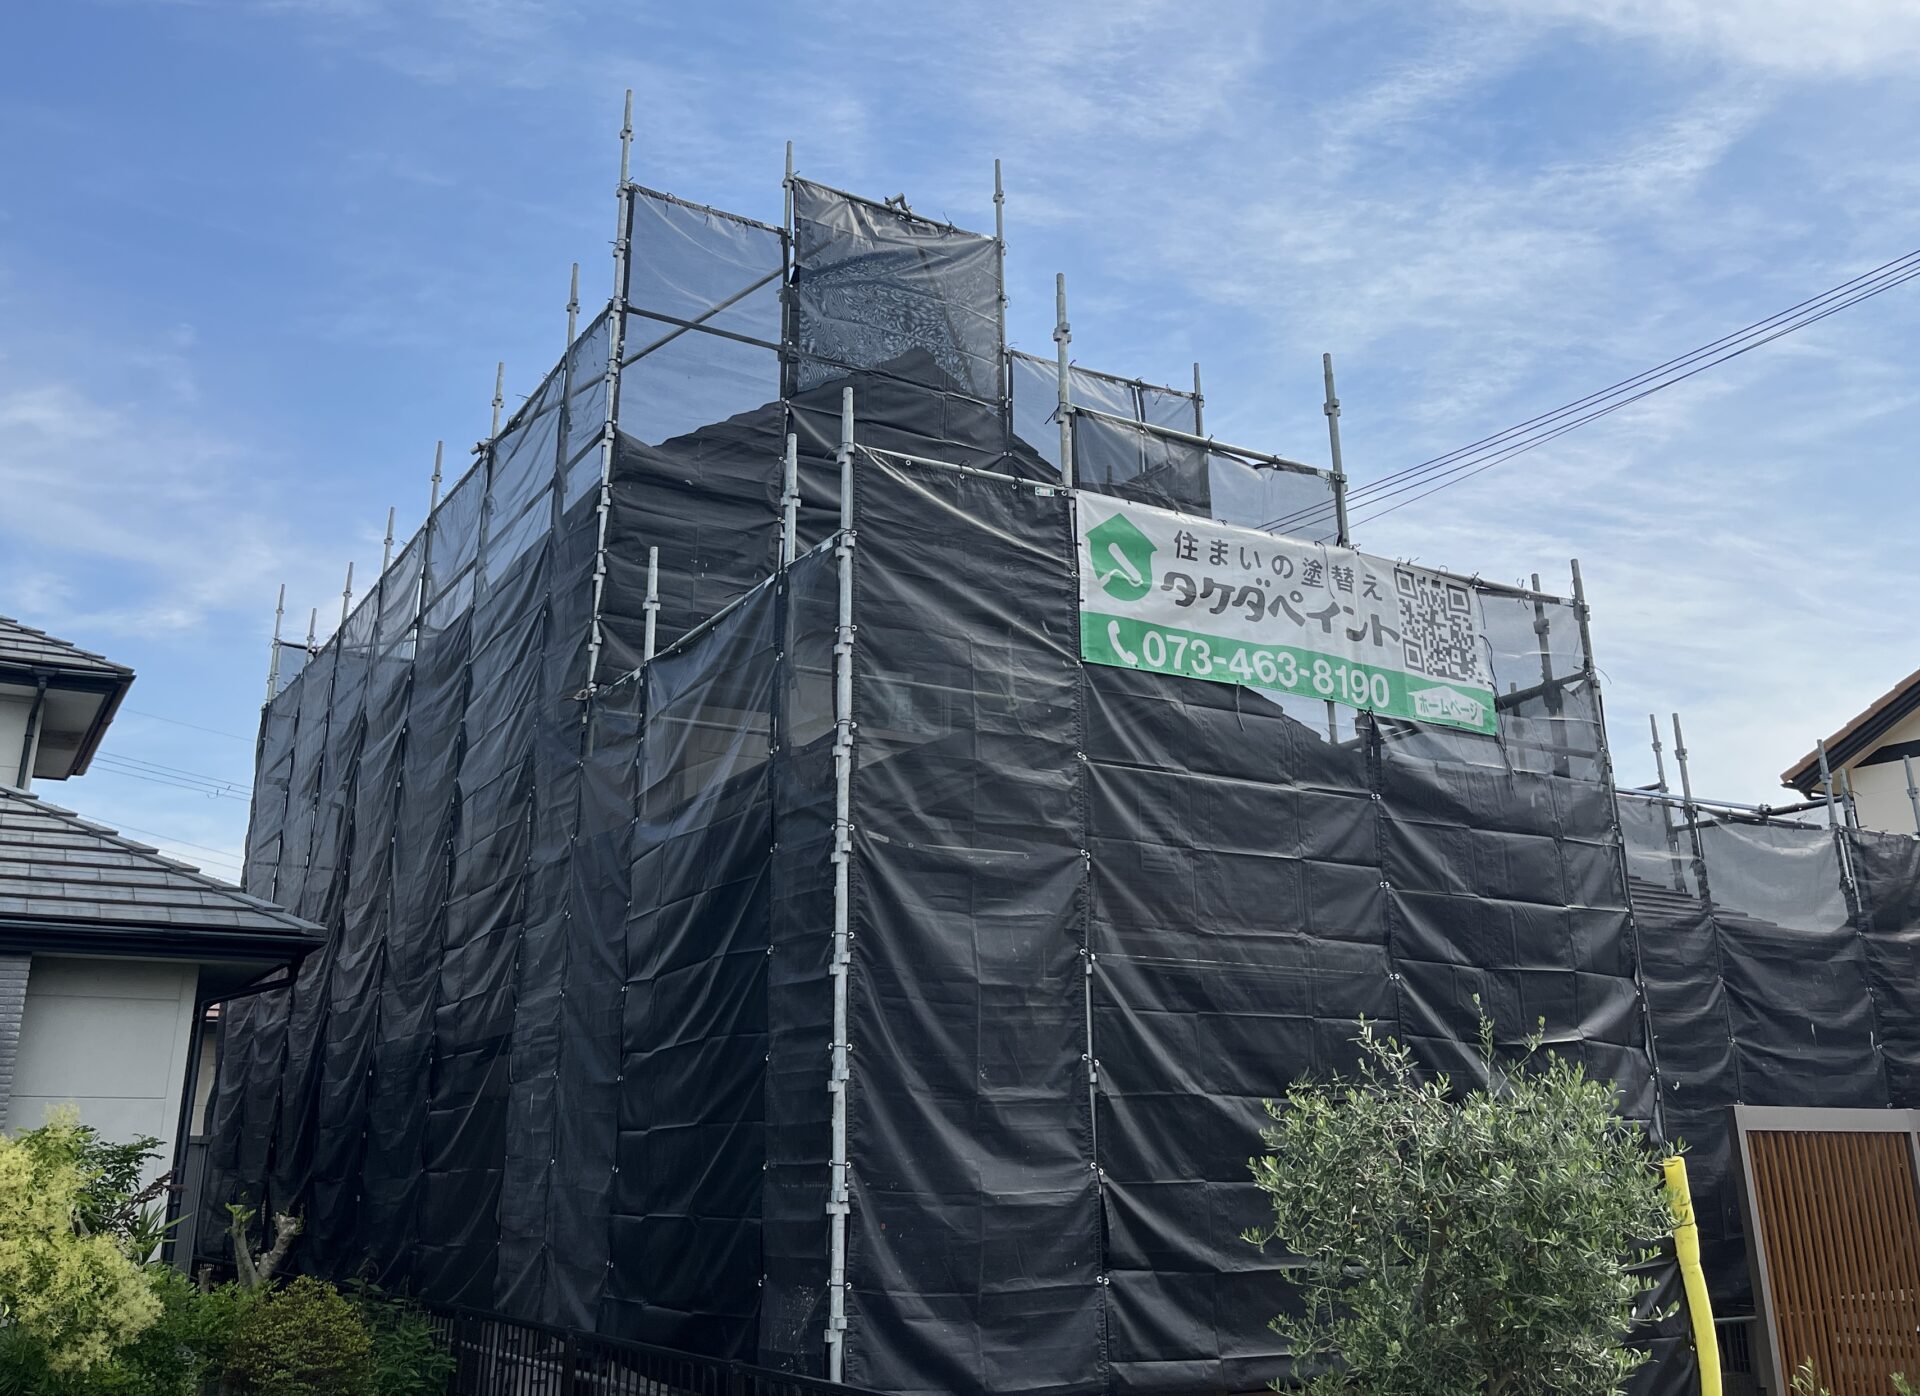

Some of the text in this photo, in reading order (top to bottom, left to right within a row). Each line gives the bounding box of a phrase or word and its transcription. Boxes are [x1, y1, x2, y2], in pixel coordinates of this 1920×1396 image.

[1174, 530, 1383, 601] 住まいの塗替え
[1161, 570, 1400, 647] タケダペイント
[1143, 630, 1390, 708] 073-463-8190
[1419, 695, 1478, 721] ホームページ
